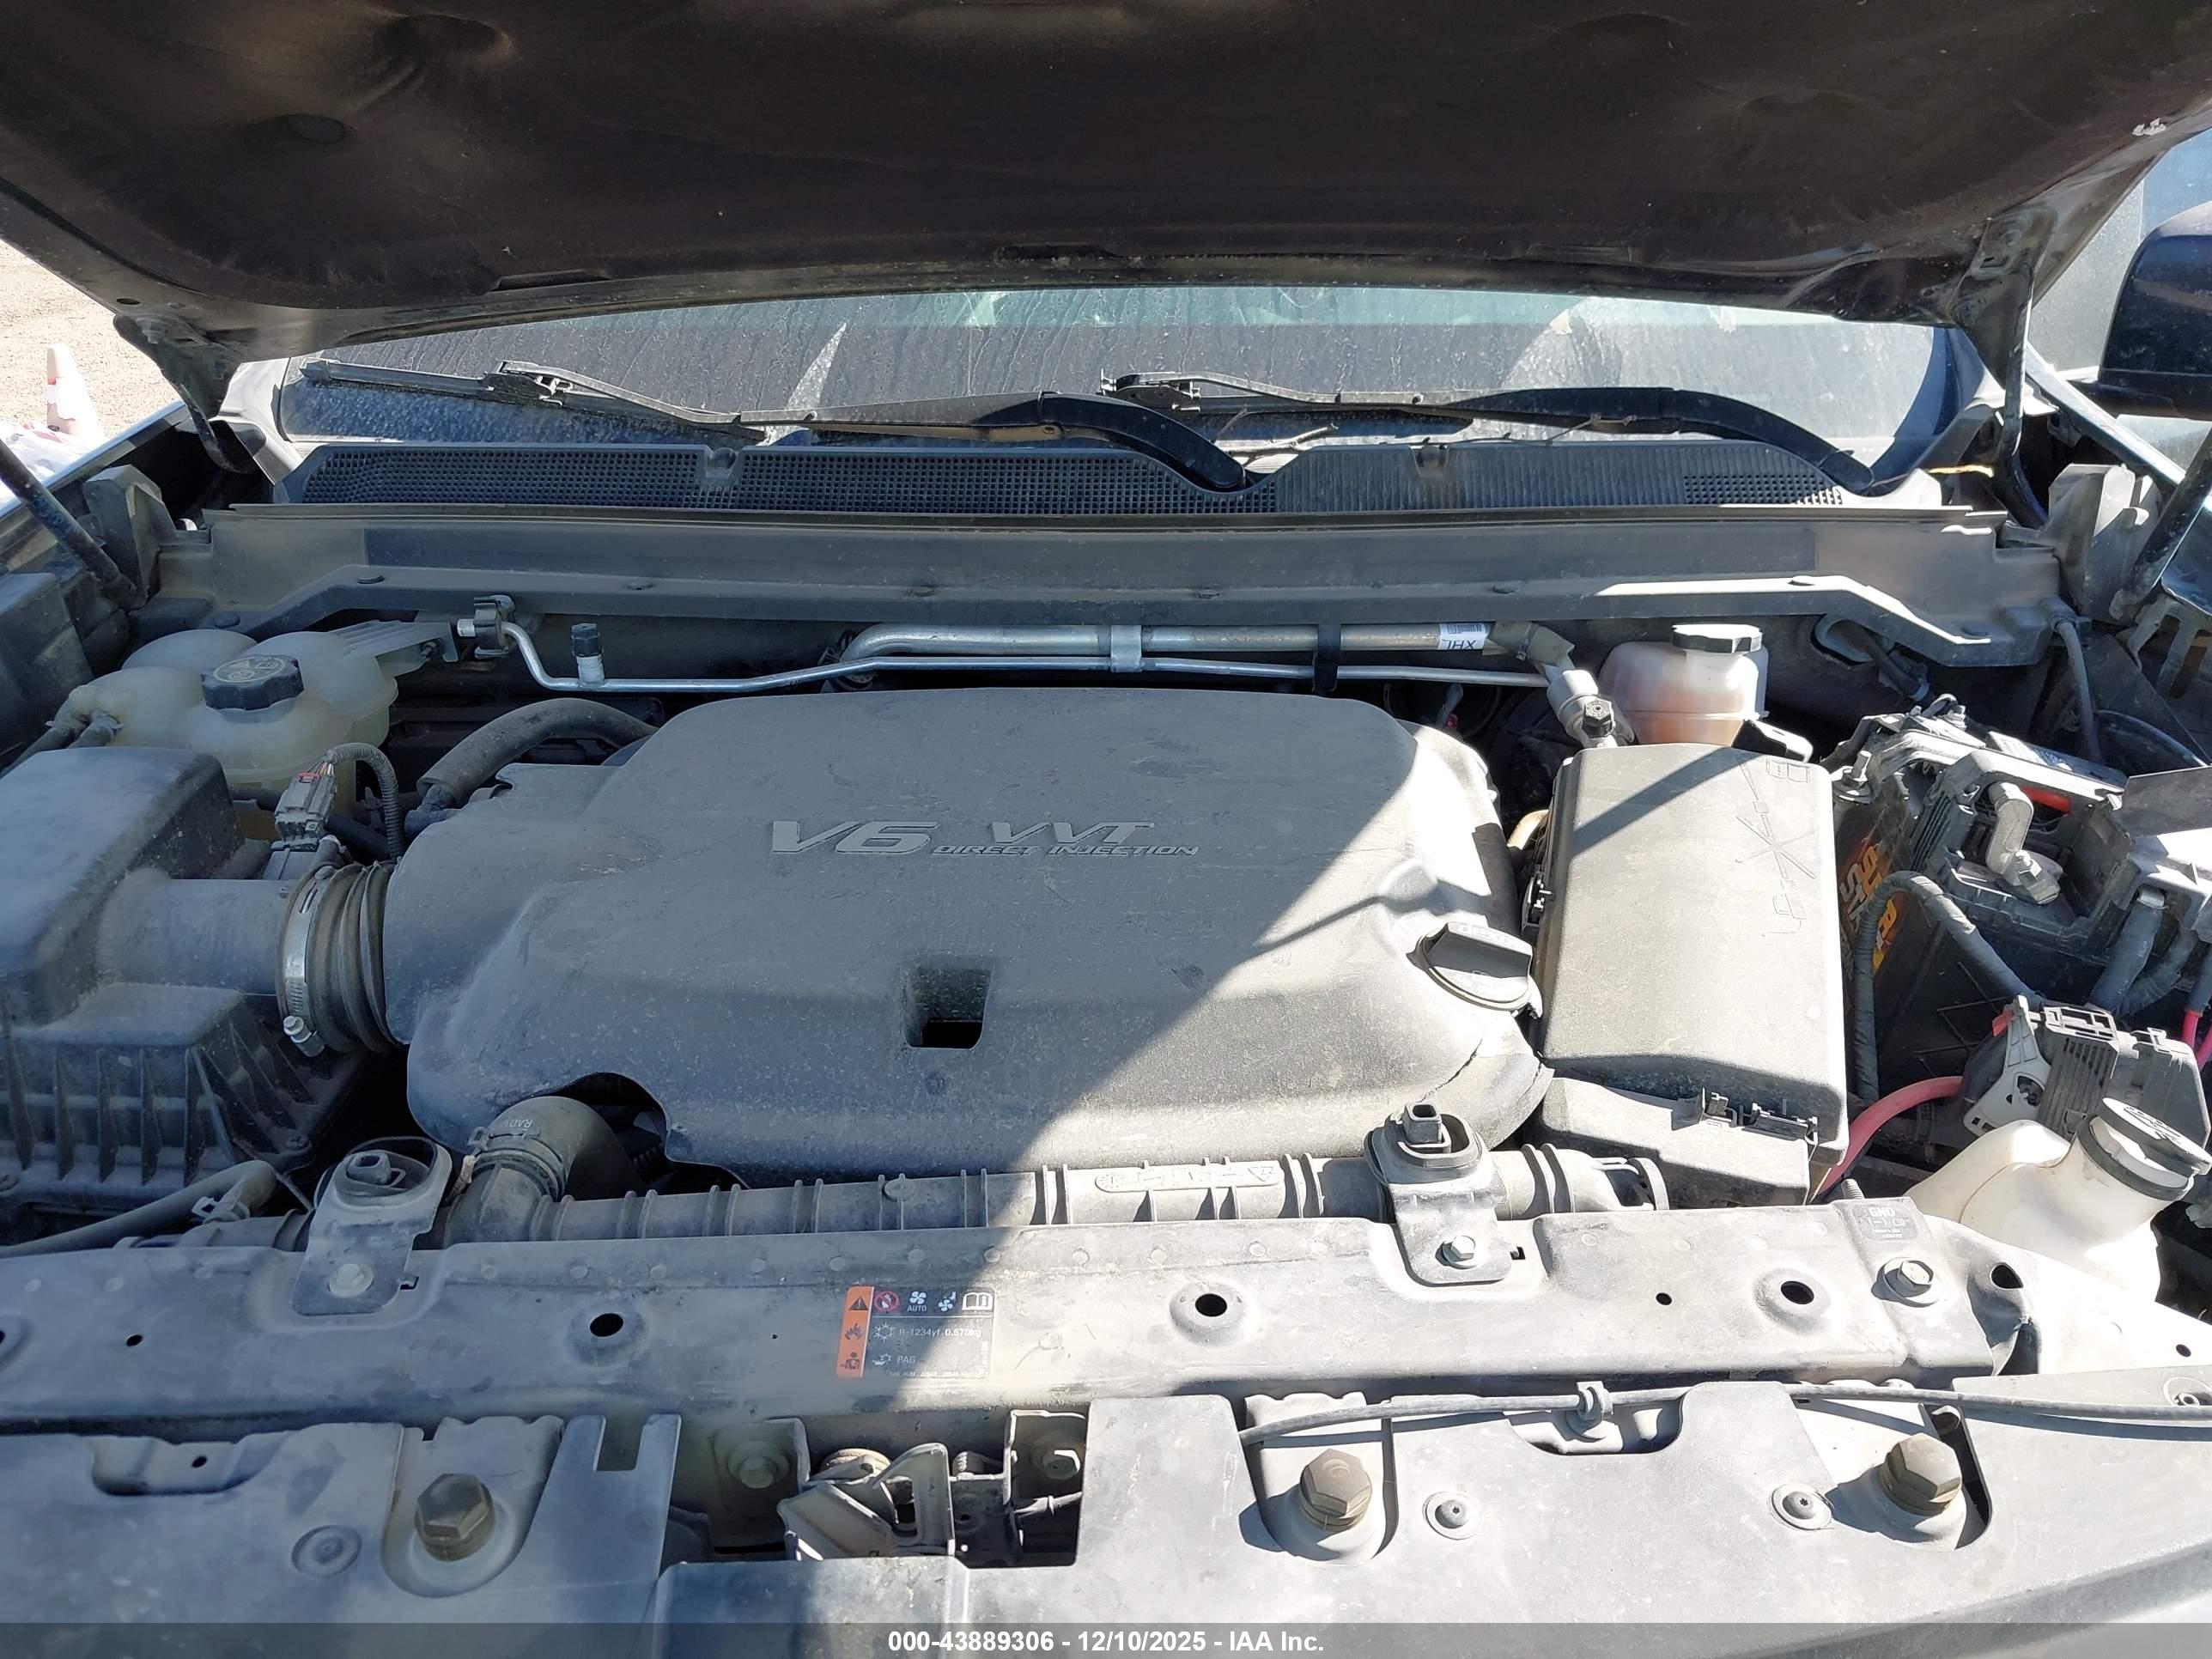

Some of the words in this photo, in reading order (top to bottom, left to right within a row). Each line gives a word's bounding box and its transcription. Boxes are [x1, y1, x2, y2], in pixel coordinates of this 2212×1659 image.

[771, 820, 940, 854] V6
[990, 822, 1156, 844] VVT
[933, 845, 1042, 856] DIRECT
[1048, 845, 1200, 856] INJECTION
[897, 1355, 916, 1364] PAG
